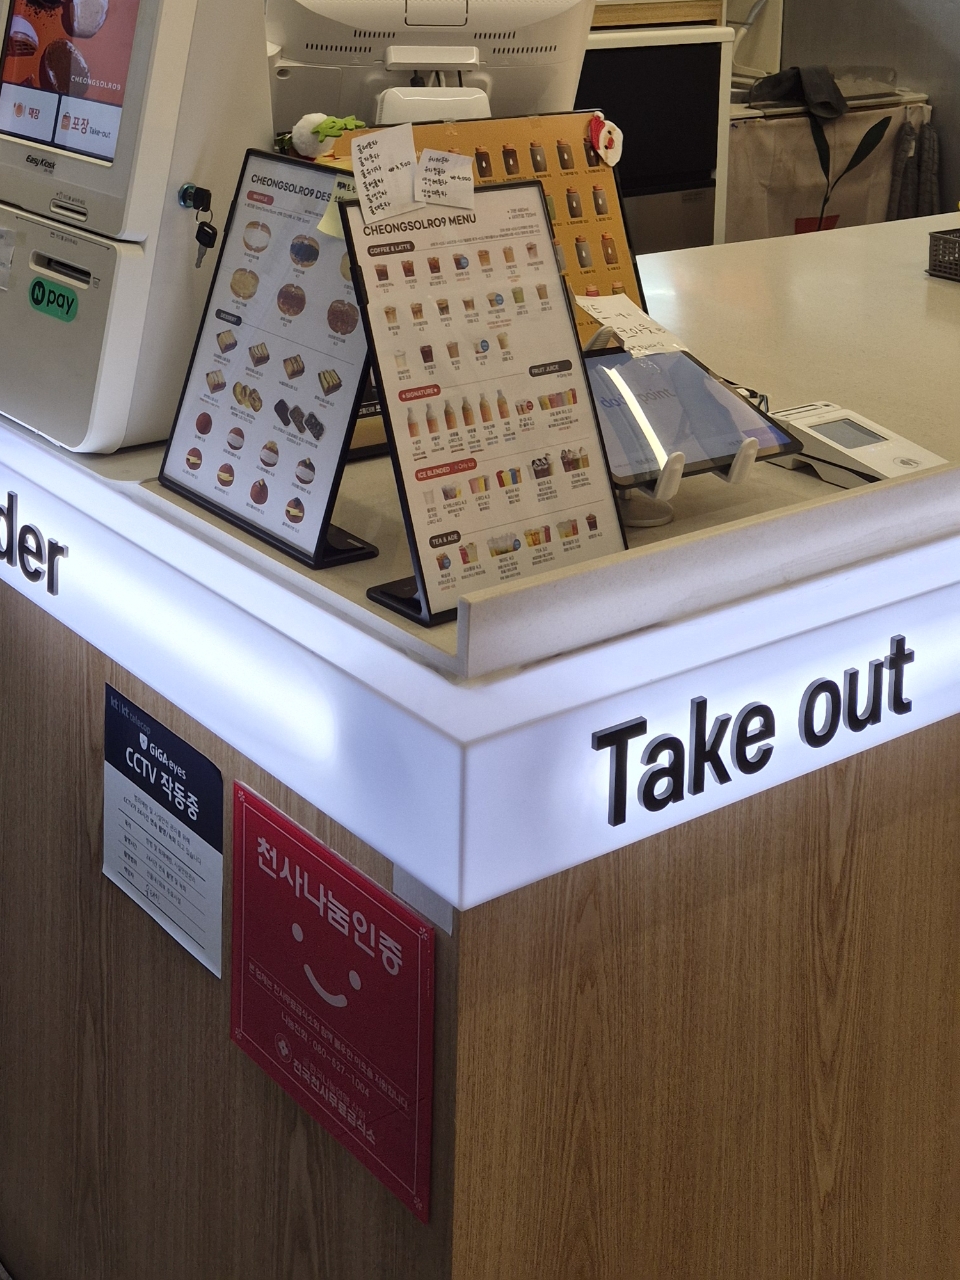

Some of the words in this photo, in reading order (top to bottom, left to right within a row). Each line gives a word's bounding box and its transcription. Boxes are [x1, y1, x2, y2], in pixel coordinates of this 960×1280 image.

[71, 75, 121, 91] CHEONGSOLRO9
[28, 107, 40, 120] 매장
[71, 116, 89, 134] 포장
[89, 126, 111, 138] Take-out
[251, 174, 315, 198] CHEONGSOLRO9
[363, 217, 447, 237] CHEONGSOLRO9
[448, 213, 477, 227] MENU
[369, 246, 390, 255] COFFEE
[395, 243, 411, 252] LATTE
[46, 289, 75, 315] pay
[532, 366, 545, 375] FRUIT
[545, 364, 559, 373] JUICE
[406, 388, 435, 399] SIGNATURE
[638, 387, 675, 405] point
[417, 470, 427, 479] ICE
[427, 466, 451, 478] BLENDED
[432, 537, 442, 546] TEA
[447, 533, 459, 543] ADE
[130, 711, 151, 735] telecop
[591, 695, 777, 827] Take
[799, 634, 915, 750] out
[125, 747, 157, 785] CCTV
[160, 770, 200, 821] 작동중
[257, 835, 403, 977] 천사나눔인증
[293, 1058, 376, 1146] 전국천사무료급식소
